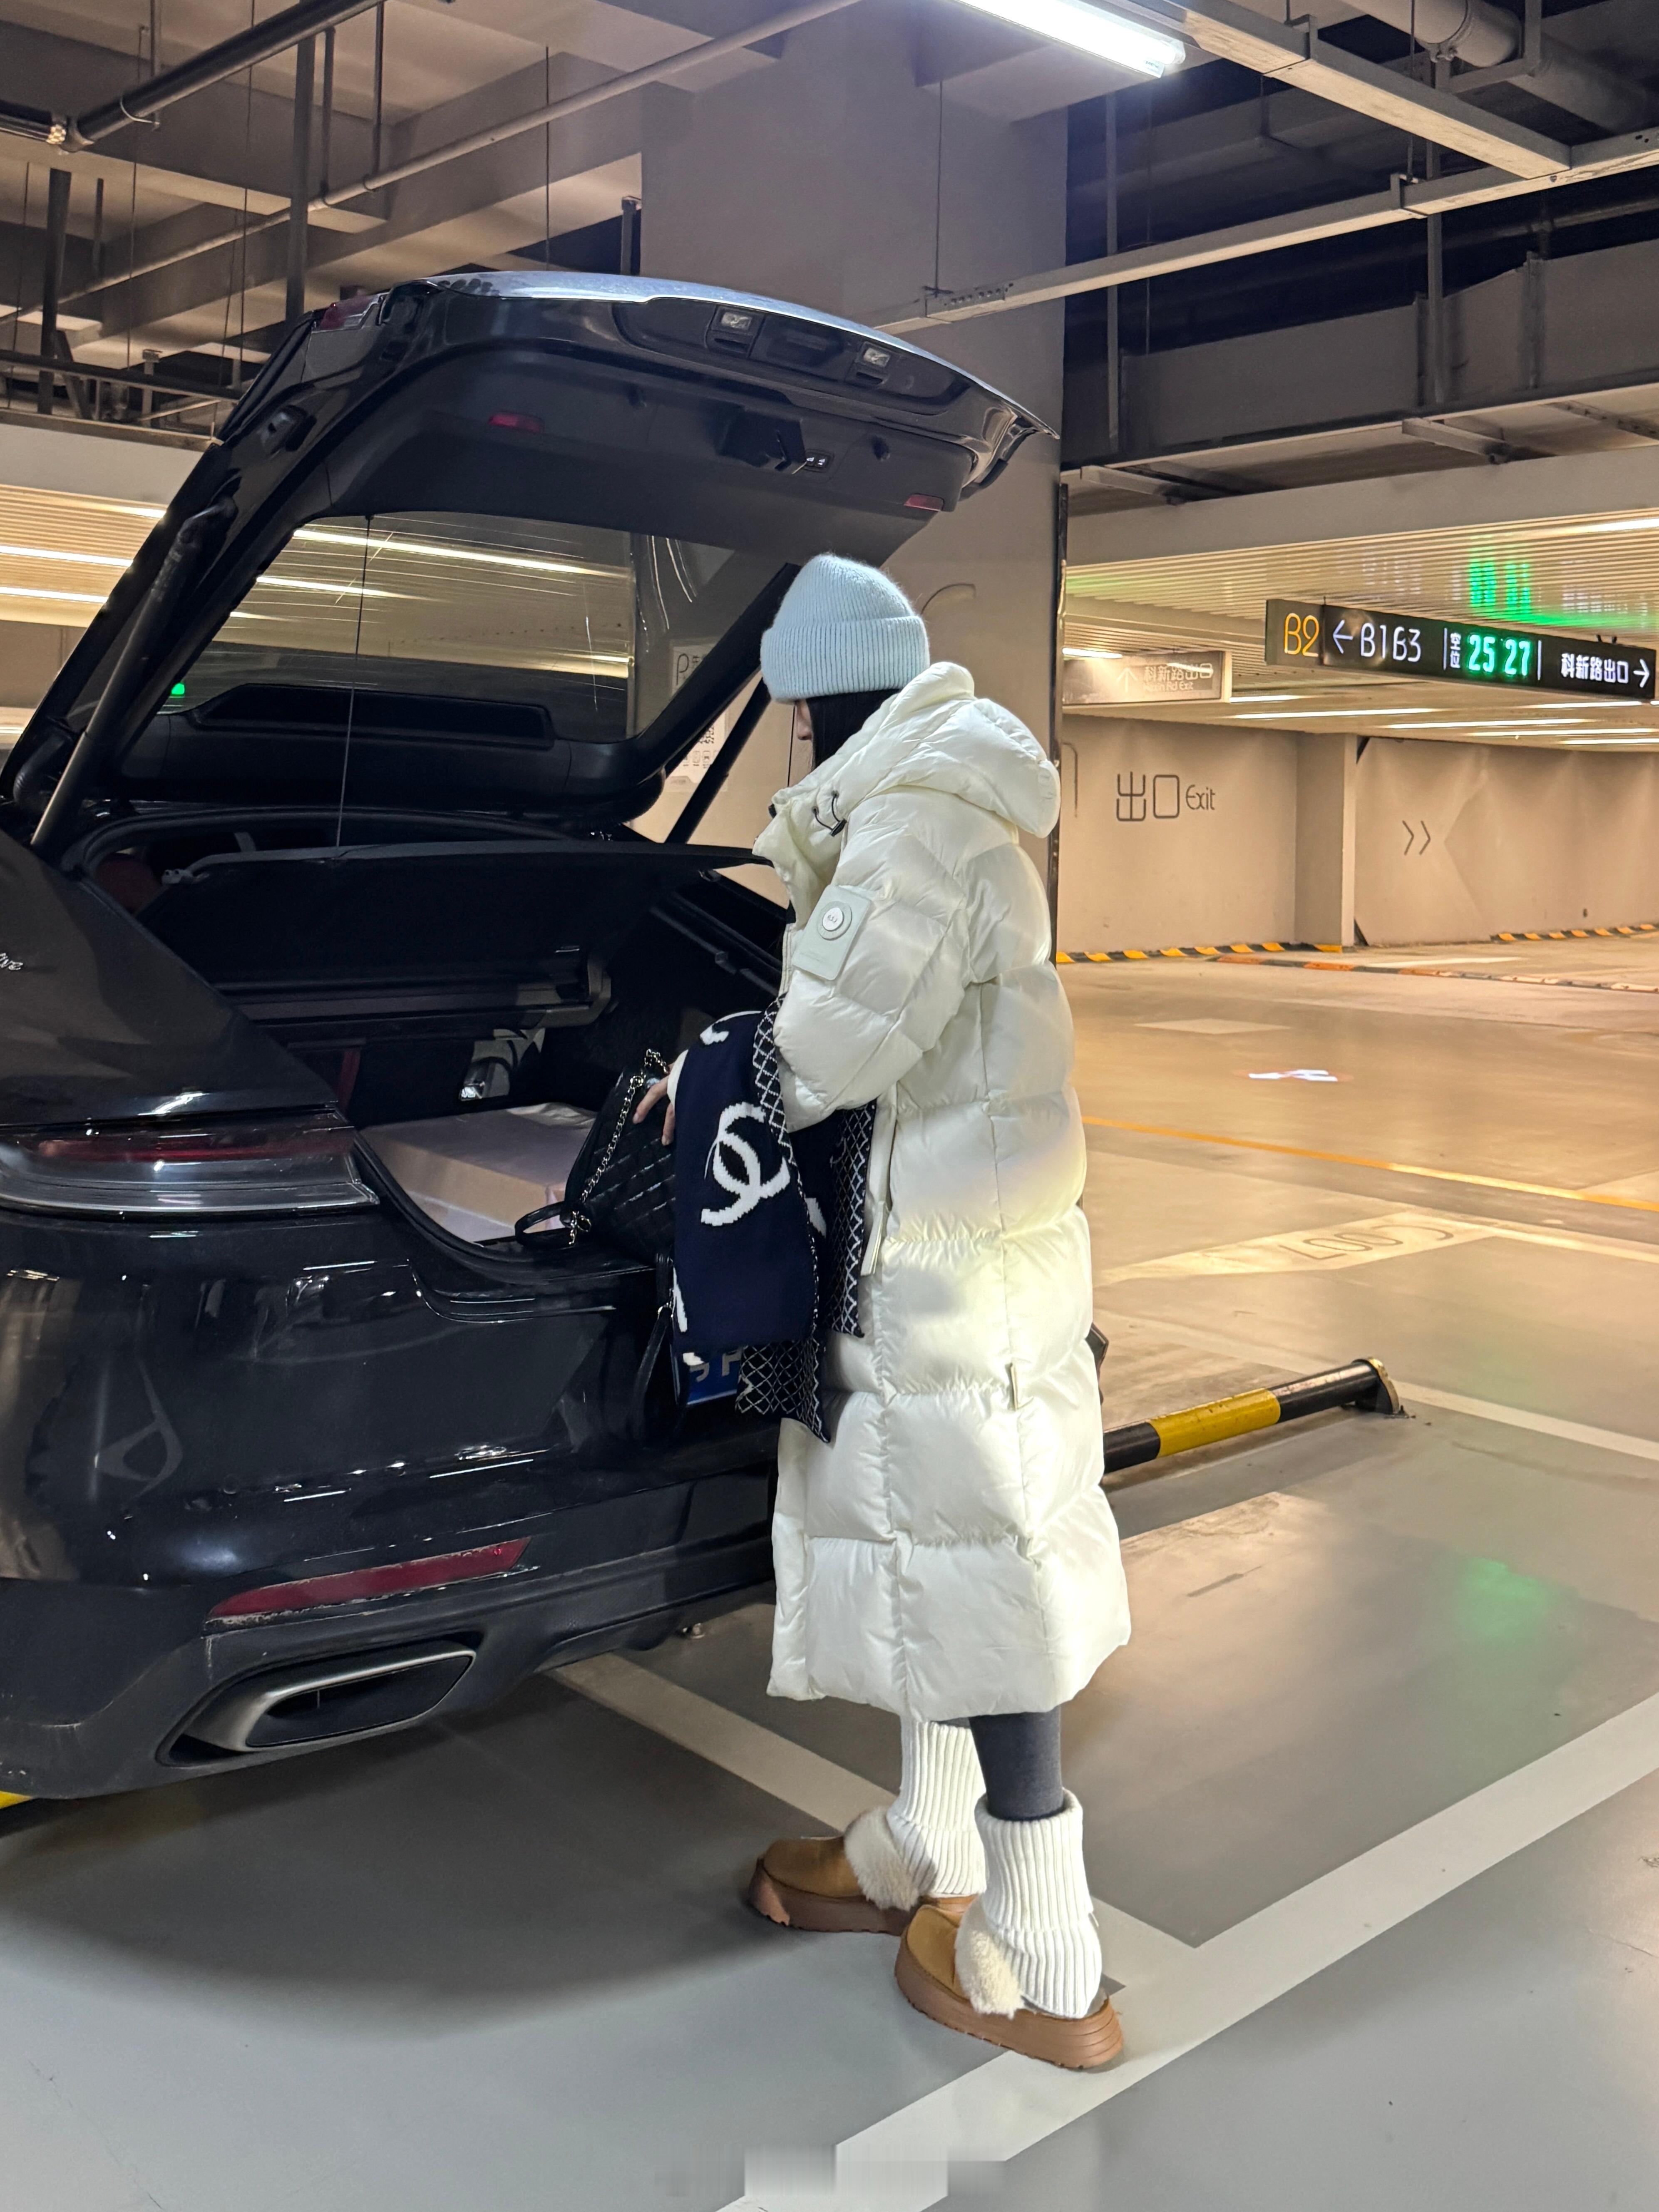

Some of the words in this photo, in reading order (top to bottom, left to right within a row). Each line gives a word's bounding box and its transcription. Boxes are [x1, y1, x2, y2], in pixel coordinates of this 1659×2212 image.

[1284, 613, 1319, 657] B2
[1116, 771, 1180, 822] 出口
[1185, 784, 1216, 810] Exit
